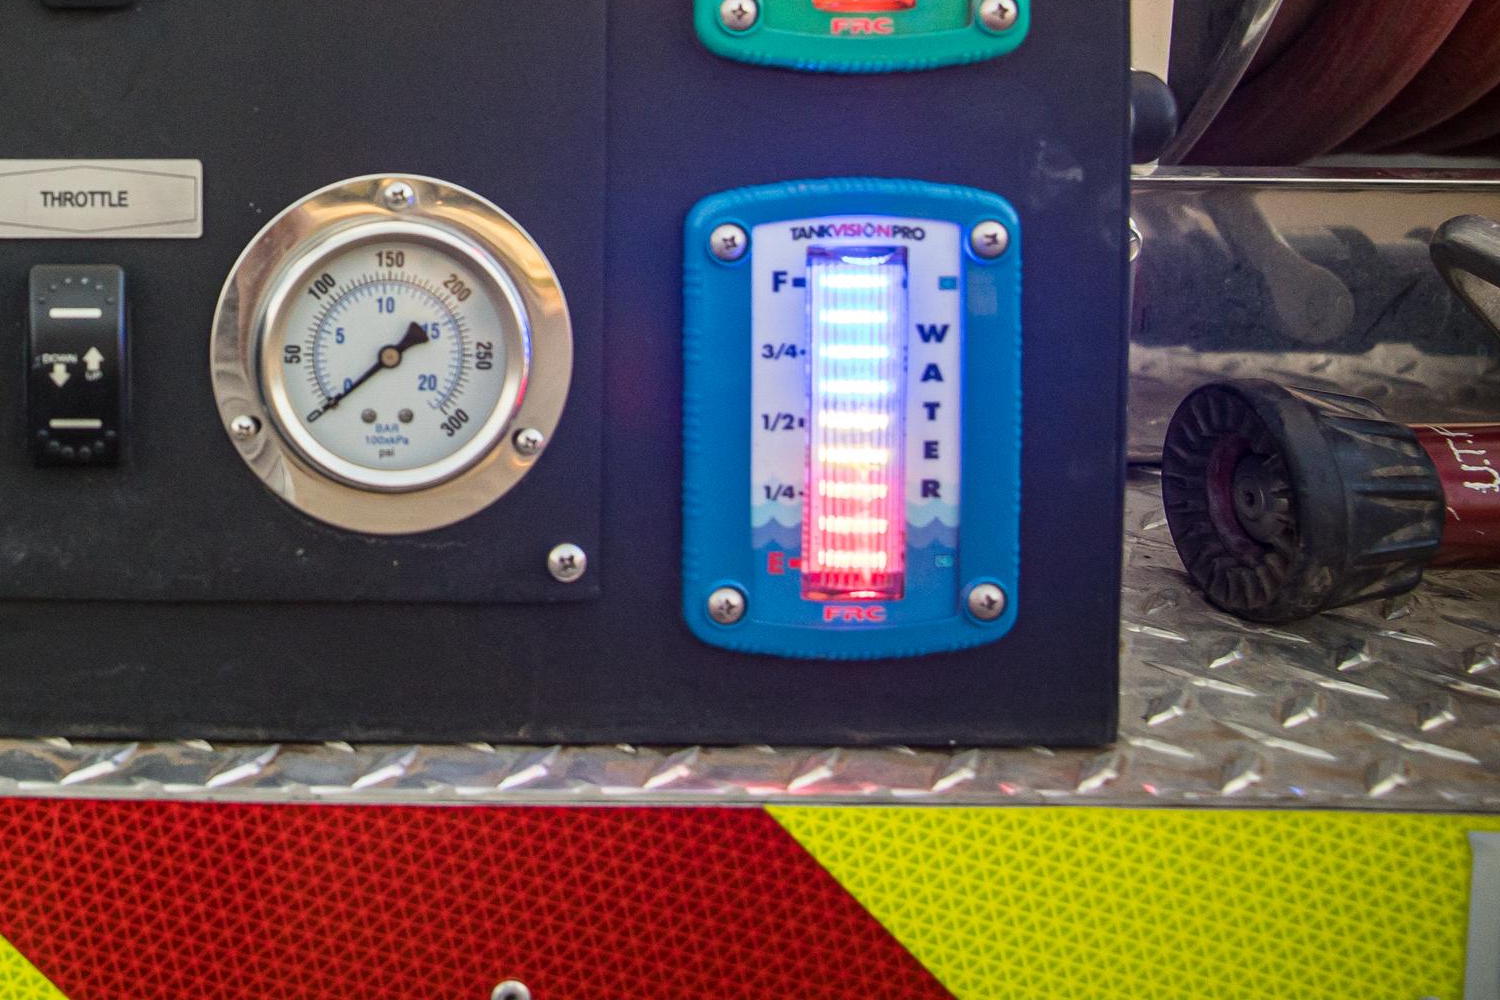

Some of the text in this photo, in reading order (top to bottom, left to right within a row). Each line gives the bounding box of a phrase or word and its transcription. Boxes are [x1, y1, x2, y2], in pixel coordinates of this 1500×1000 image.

[829, 16, 895, 35] FRC
[39, 190, 129, 209] THROTTLE
[375, 252, 405, 268] 150
[308, 273, 336, 301] 100
[442, 273, 472, 303] 200
[772, 270, 788, 293] F
[376, 296, 395, 314] 10
[335, 328, 346, 344] 5
[284, 343, 302, 365] 50
[475, 340, 493, 371] 250
[761, 343, 798, 361] 3/4
[418, 374, 438, 391] 20
[915, 322, 950, 499] WATER
[374, 423, 400, 434] BAR
[440, 407, 470, 438] 300
[761, 412, 796, 430] 1/2
[763, 484, 796, 501] 1/4
[767, 552, 784, 575] E
[822, 604, 887, 622] FRC
